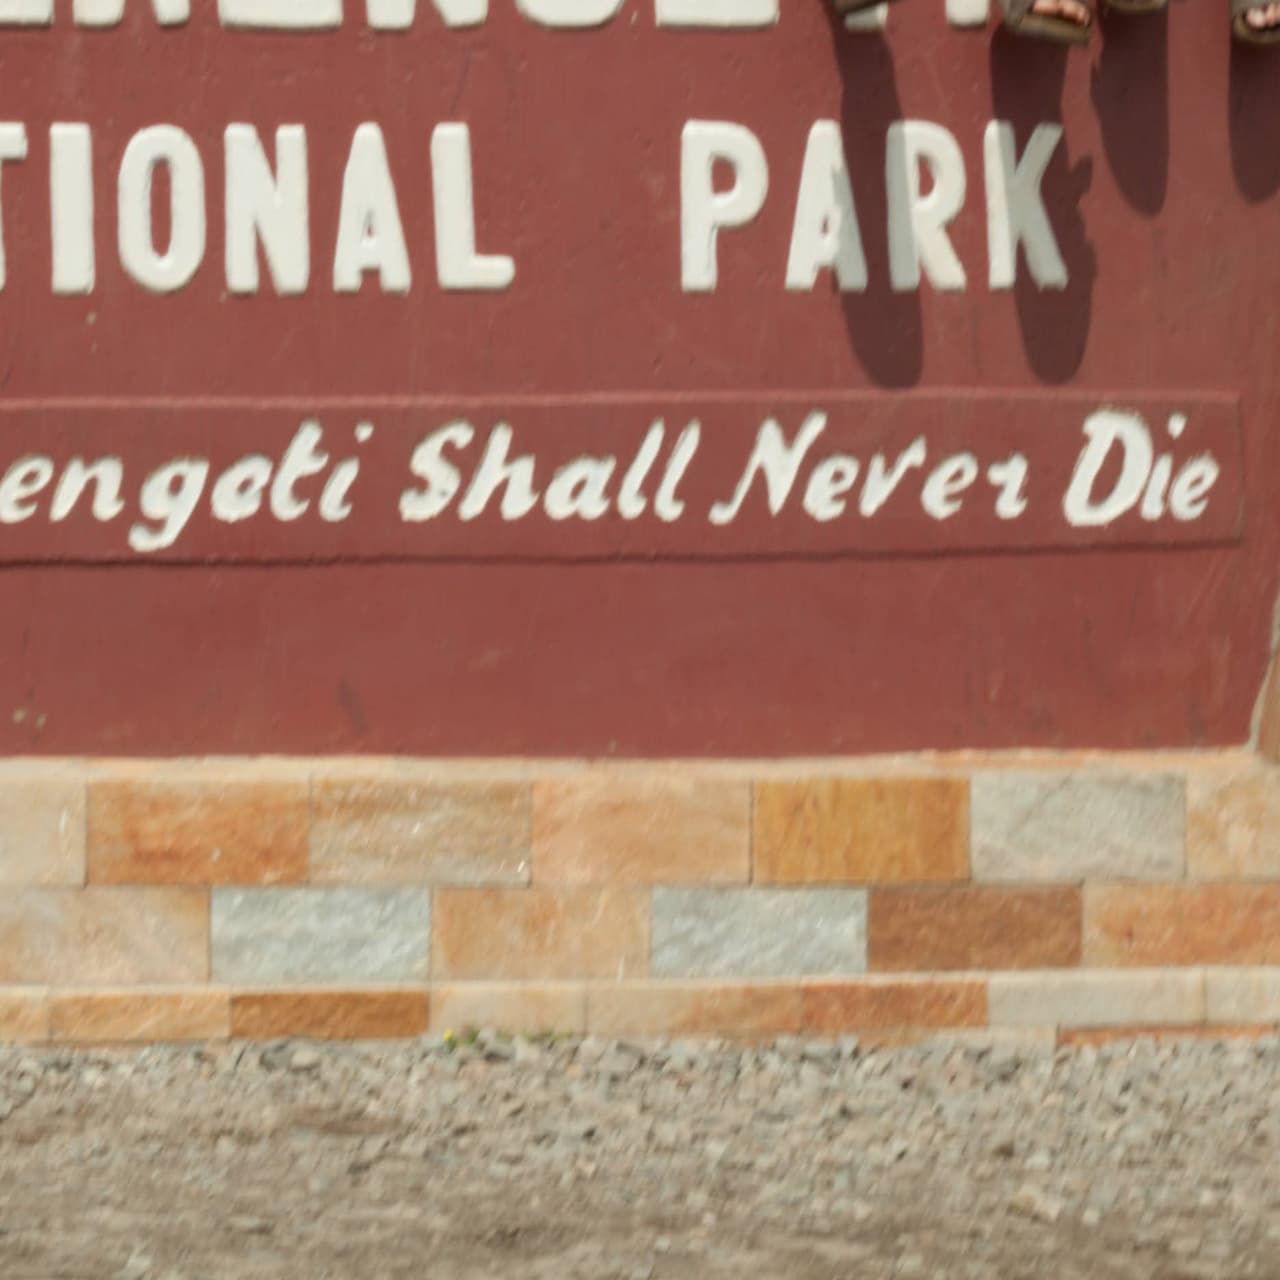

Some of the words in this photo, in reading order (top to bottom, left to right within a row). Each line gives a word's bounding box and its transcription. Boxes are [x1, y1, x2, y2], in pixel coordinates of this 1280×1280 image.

[679, 118, 1068, 293] PARK
[398, 417, 702, 524] Shall
[708, 410, 1029, 526] Never
[1062, 406, 1220, 528] Die
